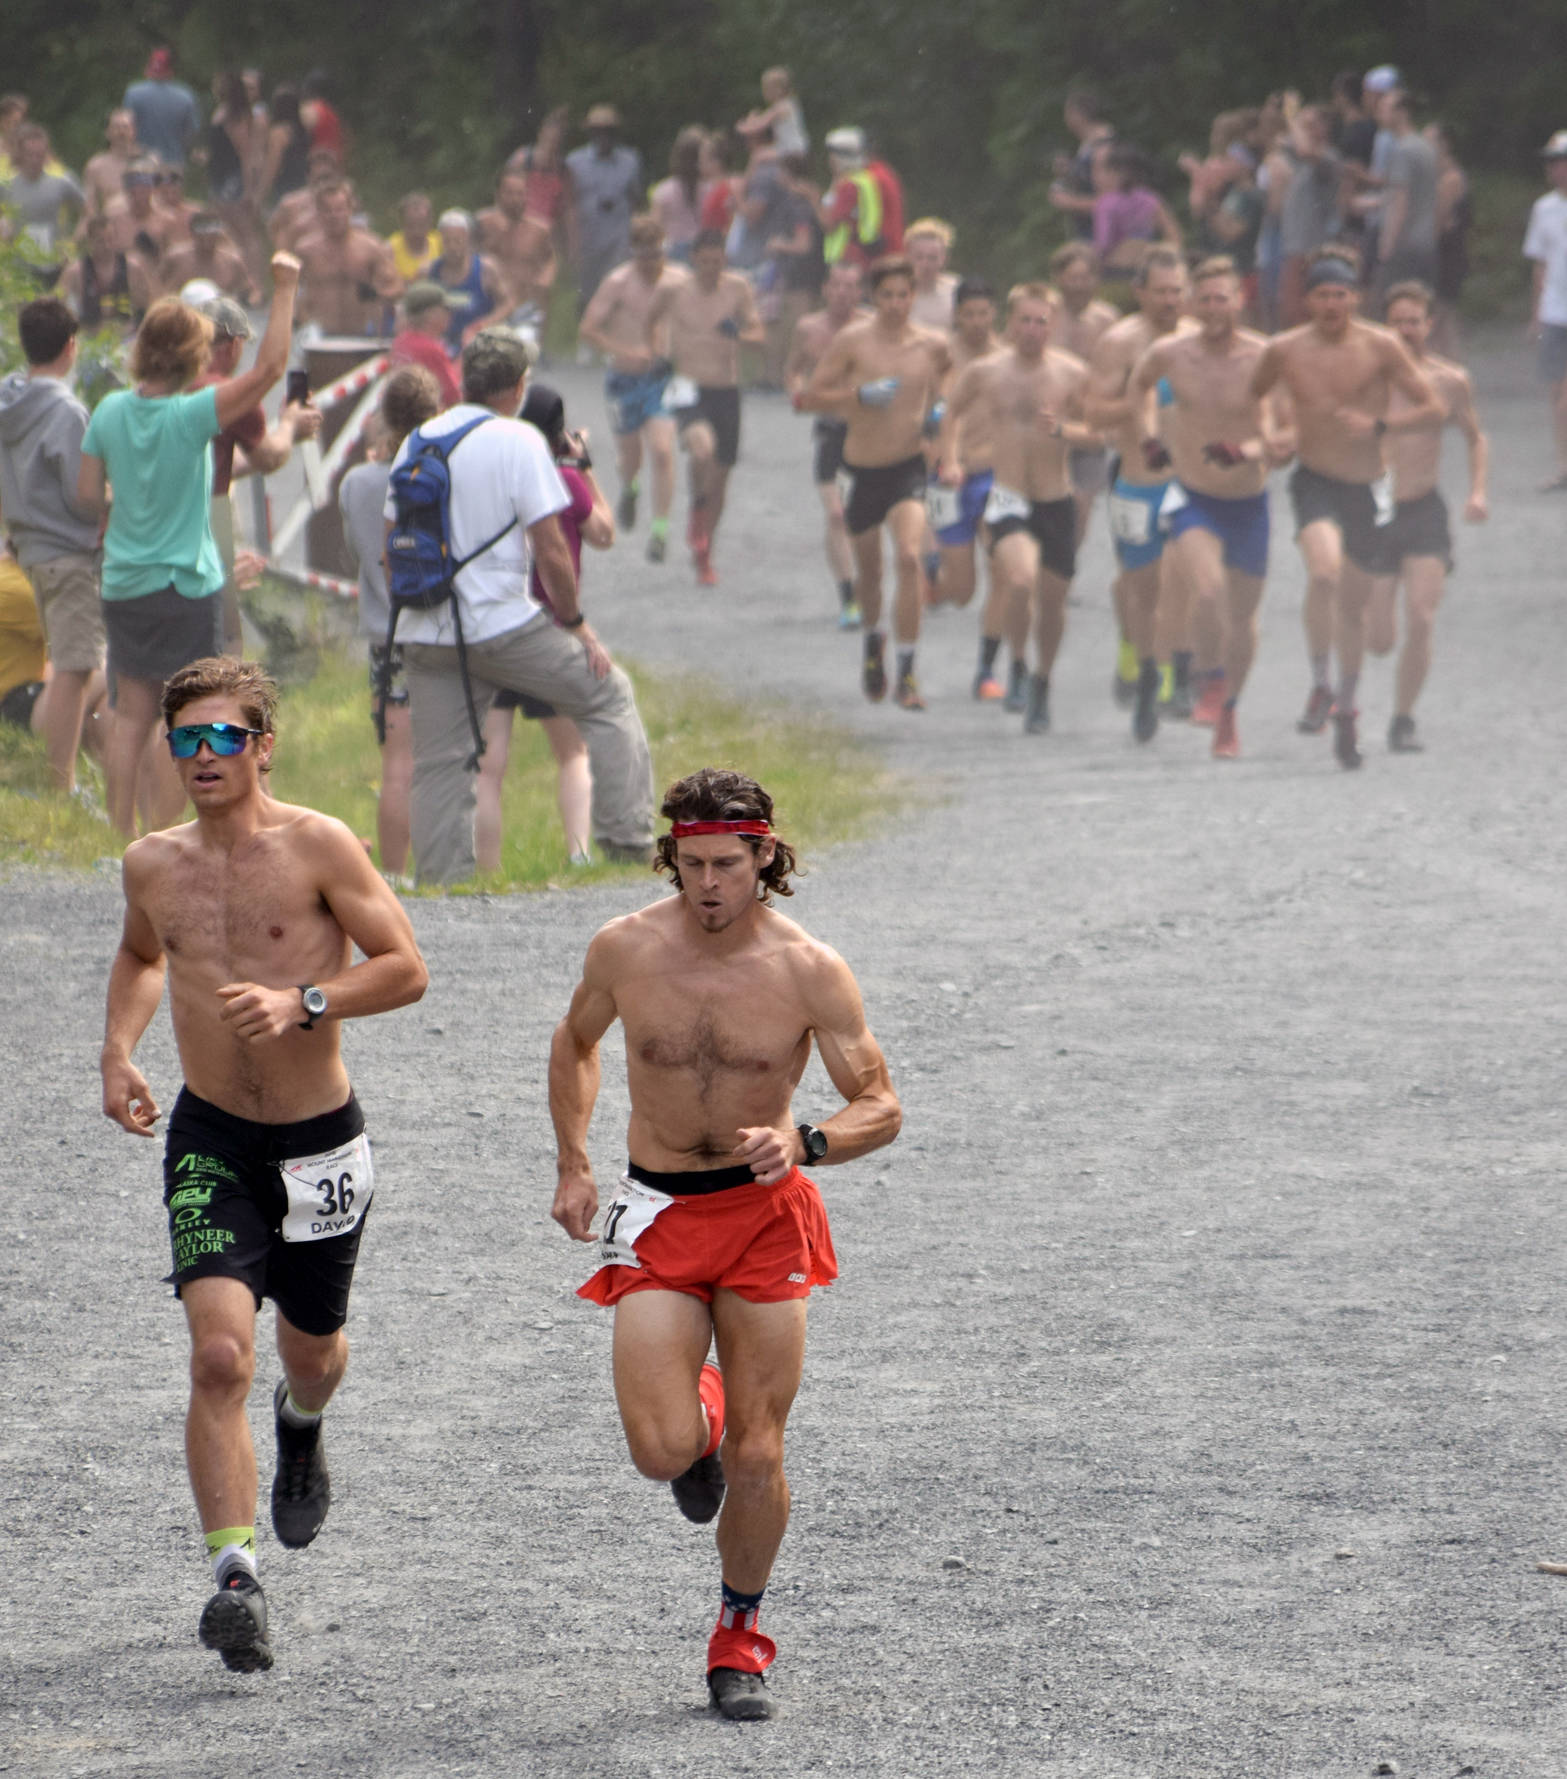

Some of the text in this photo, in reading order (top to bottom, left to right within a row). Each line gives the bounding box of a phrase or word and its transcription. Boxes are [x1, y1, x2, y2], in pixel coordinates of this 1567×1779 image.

[316, 1172, 355, 1216] 36
[311, 1215, 355, 1234] DAVID
[175, 1241, 224, 1261] AYLOR
